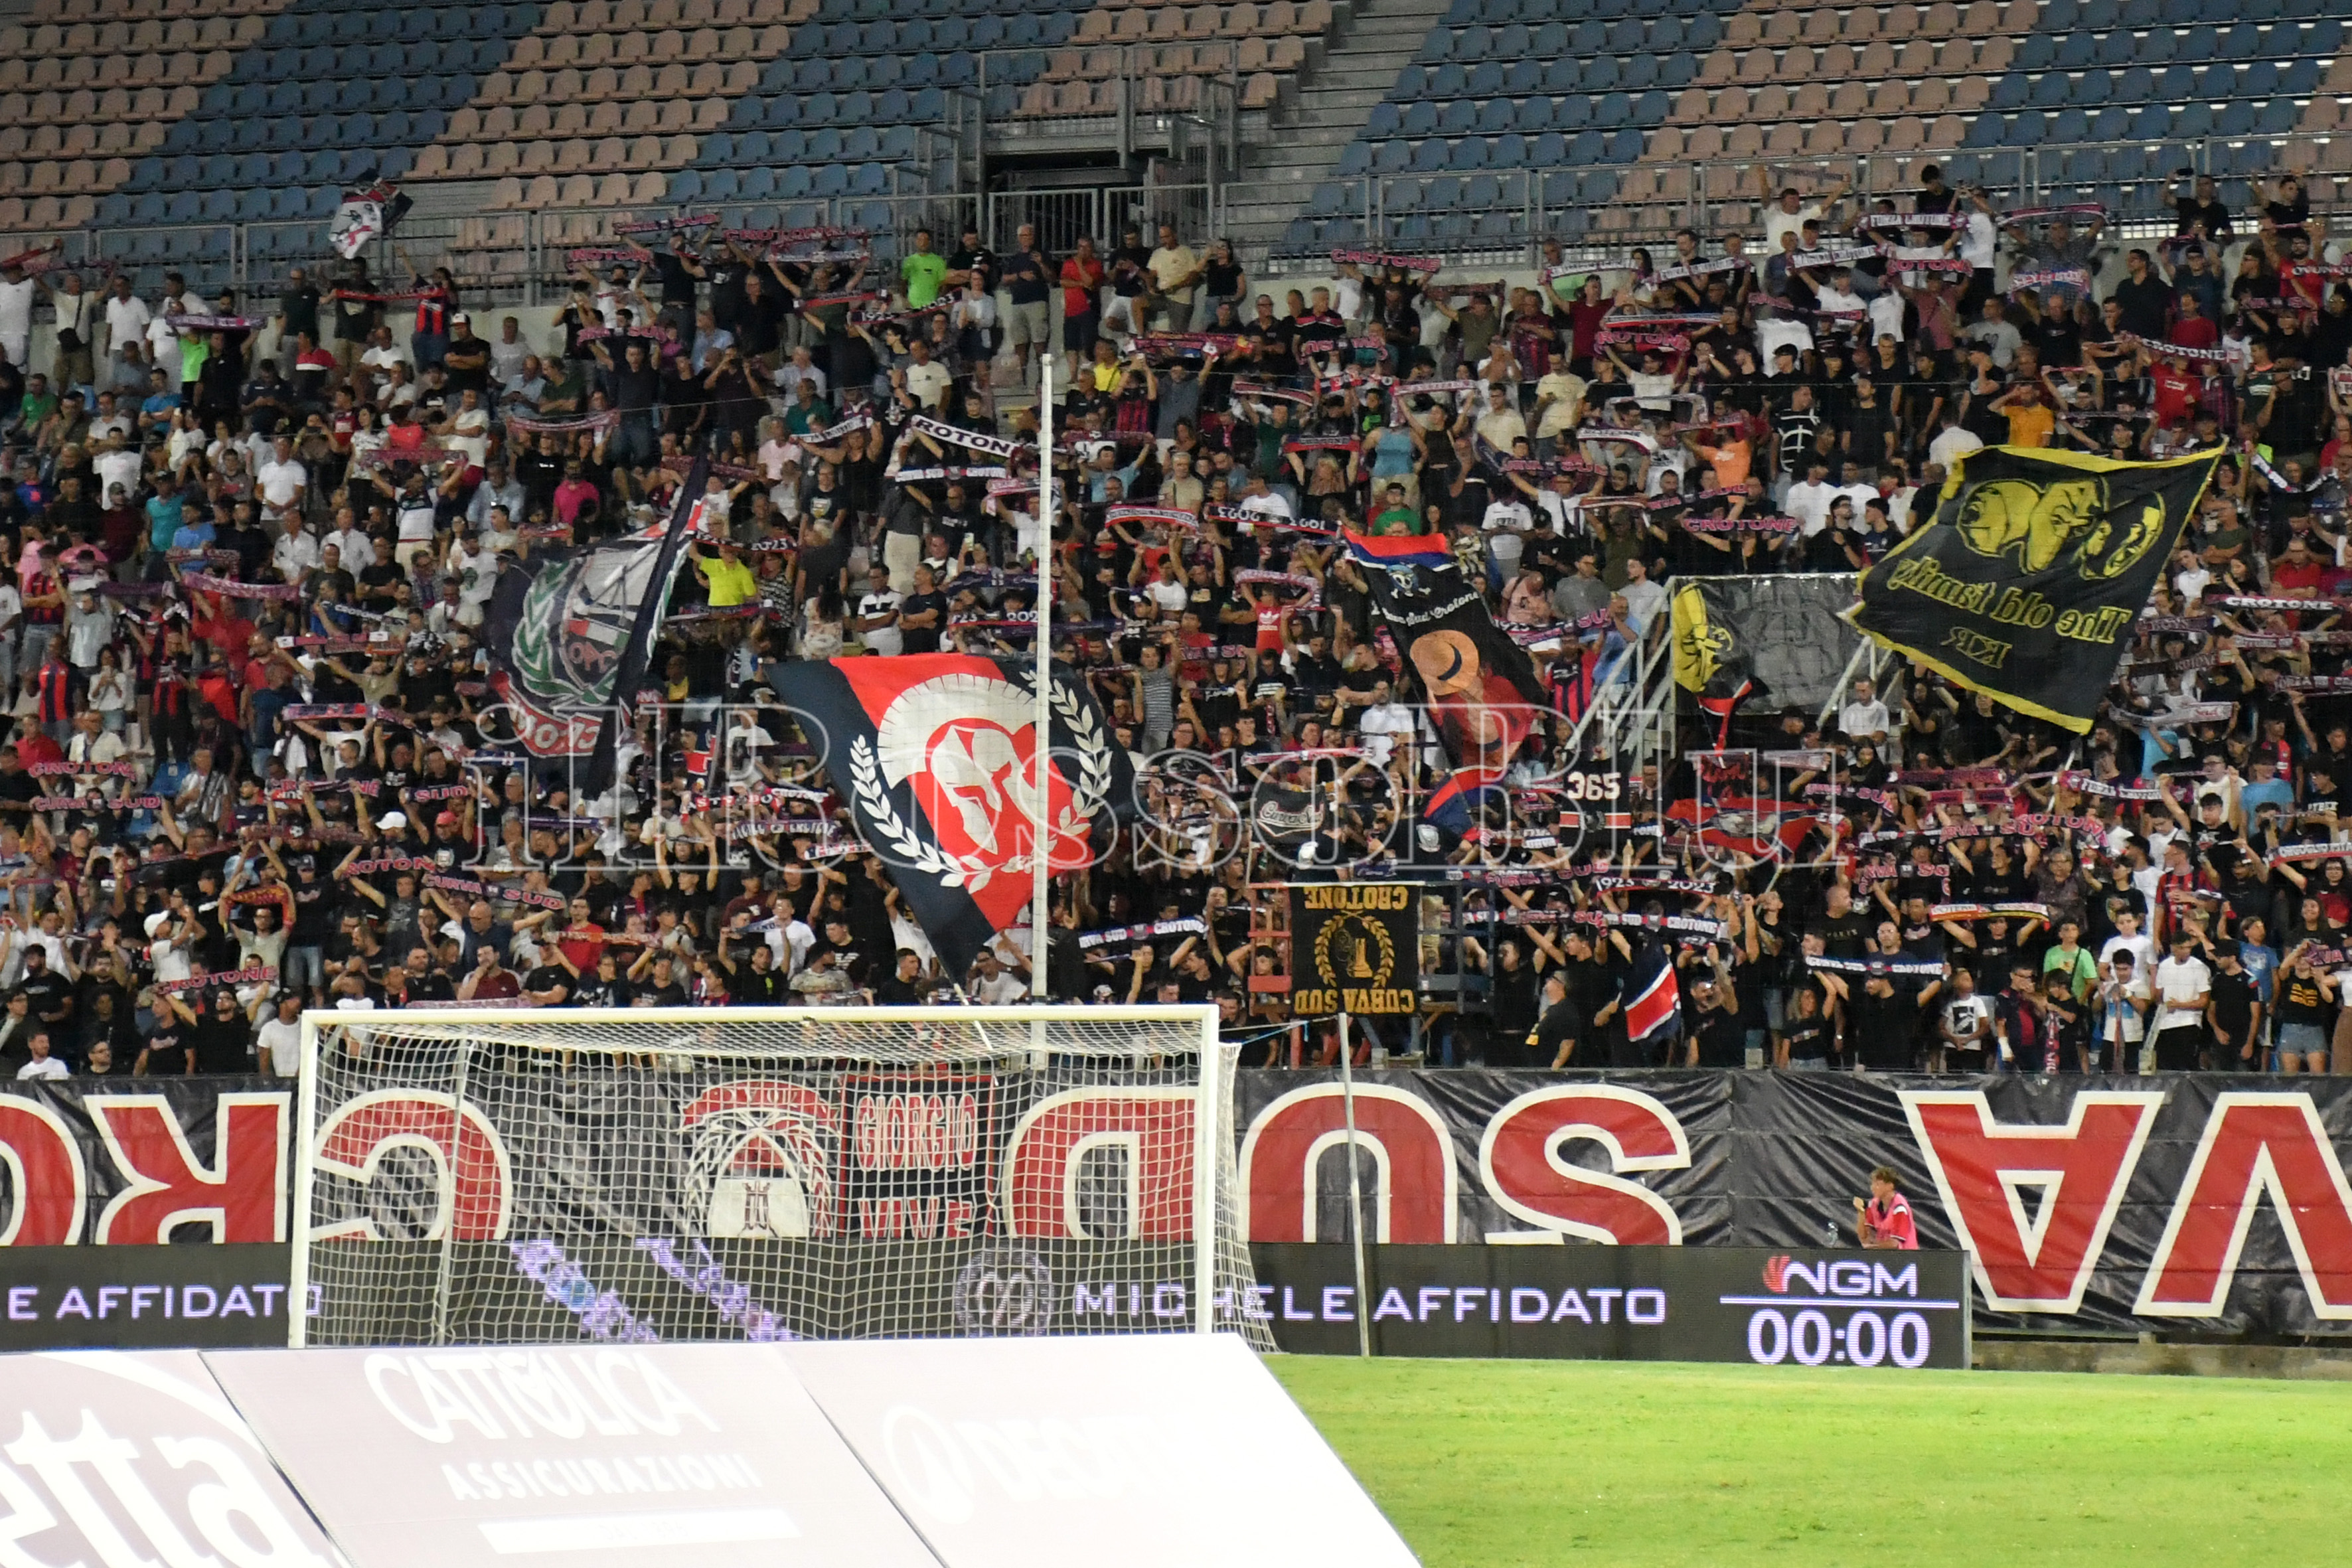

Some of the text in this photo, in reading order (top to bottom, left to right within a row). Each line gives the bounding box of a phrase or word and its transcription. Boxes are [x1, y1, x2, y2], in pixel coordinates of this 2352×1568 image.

[1330, 248, 1441, 274] CROTONE
[2142, 337, 2226, 361] CROTONE
[911, 418, 1012, 459] ROTON
[1684, 518, 1798, 532] CROTONE
[1006, 610, 1038, 622] 202
[1431, 591, 1480, 619] Crotone
[2225, 597, 2333, 610] CROTONE
[415, 786, 467, 801] SUD
[1567, 771, 1621, 801] 365
[108, 796, 162, 809] SUD
[426, 874, 564, 911] CURVA SUD
[1303, 886, 1409, 910] CROTONE
[1596, 876, 1715, 894] 1923 2023
[1294, 988, 1415, 1015] CURVA SUD
[856, 1095, 978, 1172] GIORGIO
[1004, 1082, 1691, 1245] SUD
[859, 1196, 974, 1239] VIVE
[1784, 1260, 1917, 1296] NGM
[0, 1285, 324, 1318] E AFFIDATO
[1076, 1283, 1666, 1324] MICHELE AFFIDATO
[1747, 1310, 1930, 1368] 00:00
[443, 1452, 763, 1501] ASSICURAZIONI
